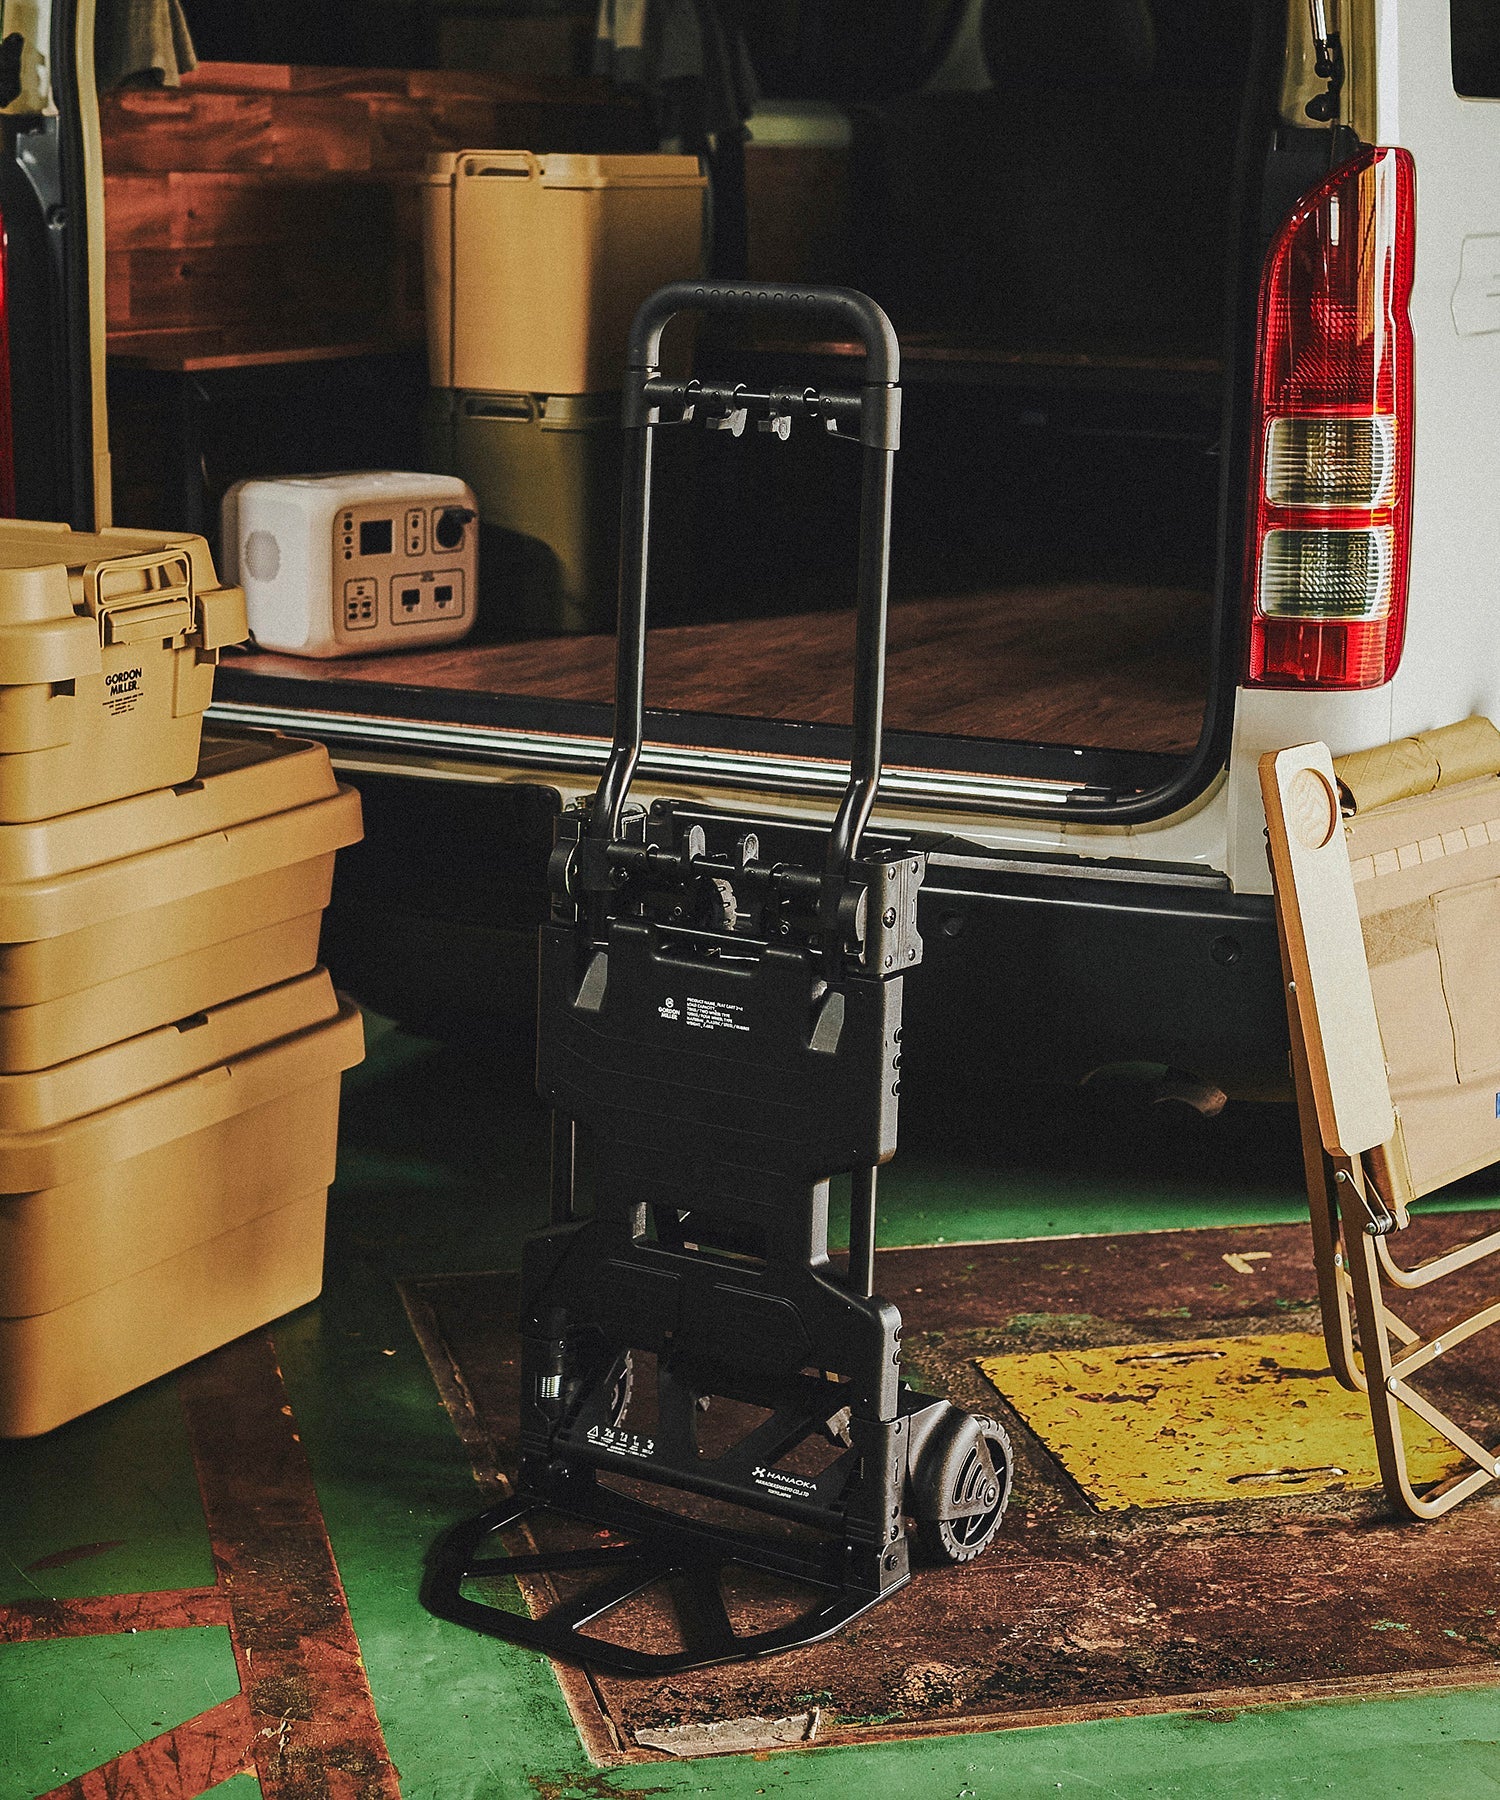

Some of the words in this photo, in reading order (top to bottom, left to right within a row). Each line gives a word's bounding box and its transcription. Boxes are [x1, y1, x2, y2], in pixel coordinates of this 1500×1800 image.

[105, 667, 142, 686] GORDON
[658, 1006, 680, 1016] GORDON
[766, 1472, 817, 1490] HANAOKA
